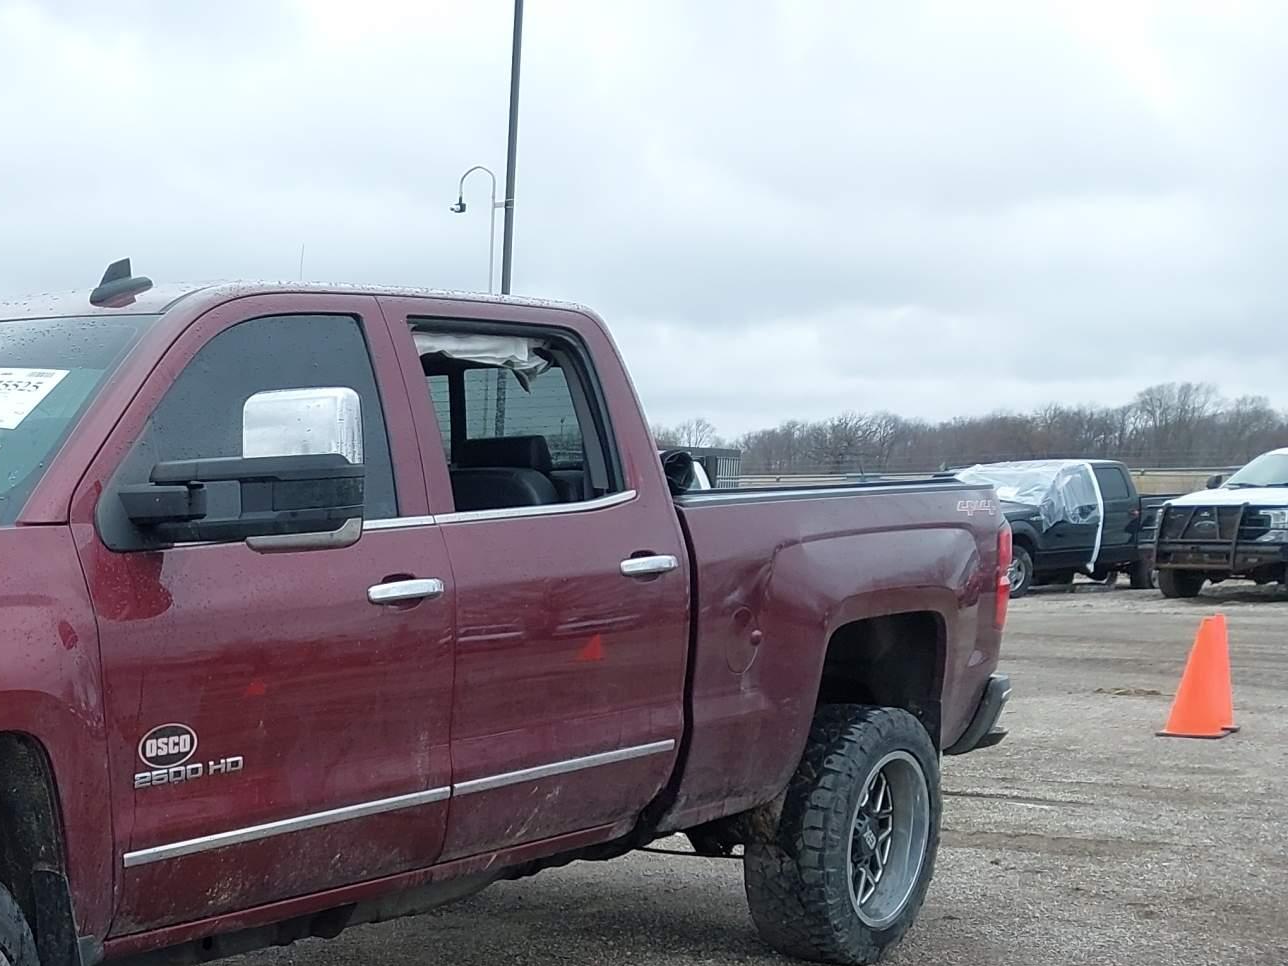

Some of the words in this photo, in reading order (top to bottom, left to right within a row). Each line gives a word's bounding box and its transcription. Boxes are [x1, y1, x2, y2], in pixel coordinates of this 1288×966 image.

[145, 734, 191, 758] OSCO
[134, 763, 203, 789] 2500
[209, 756, 244, 775] HD
